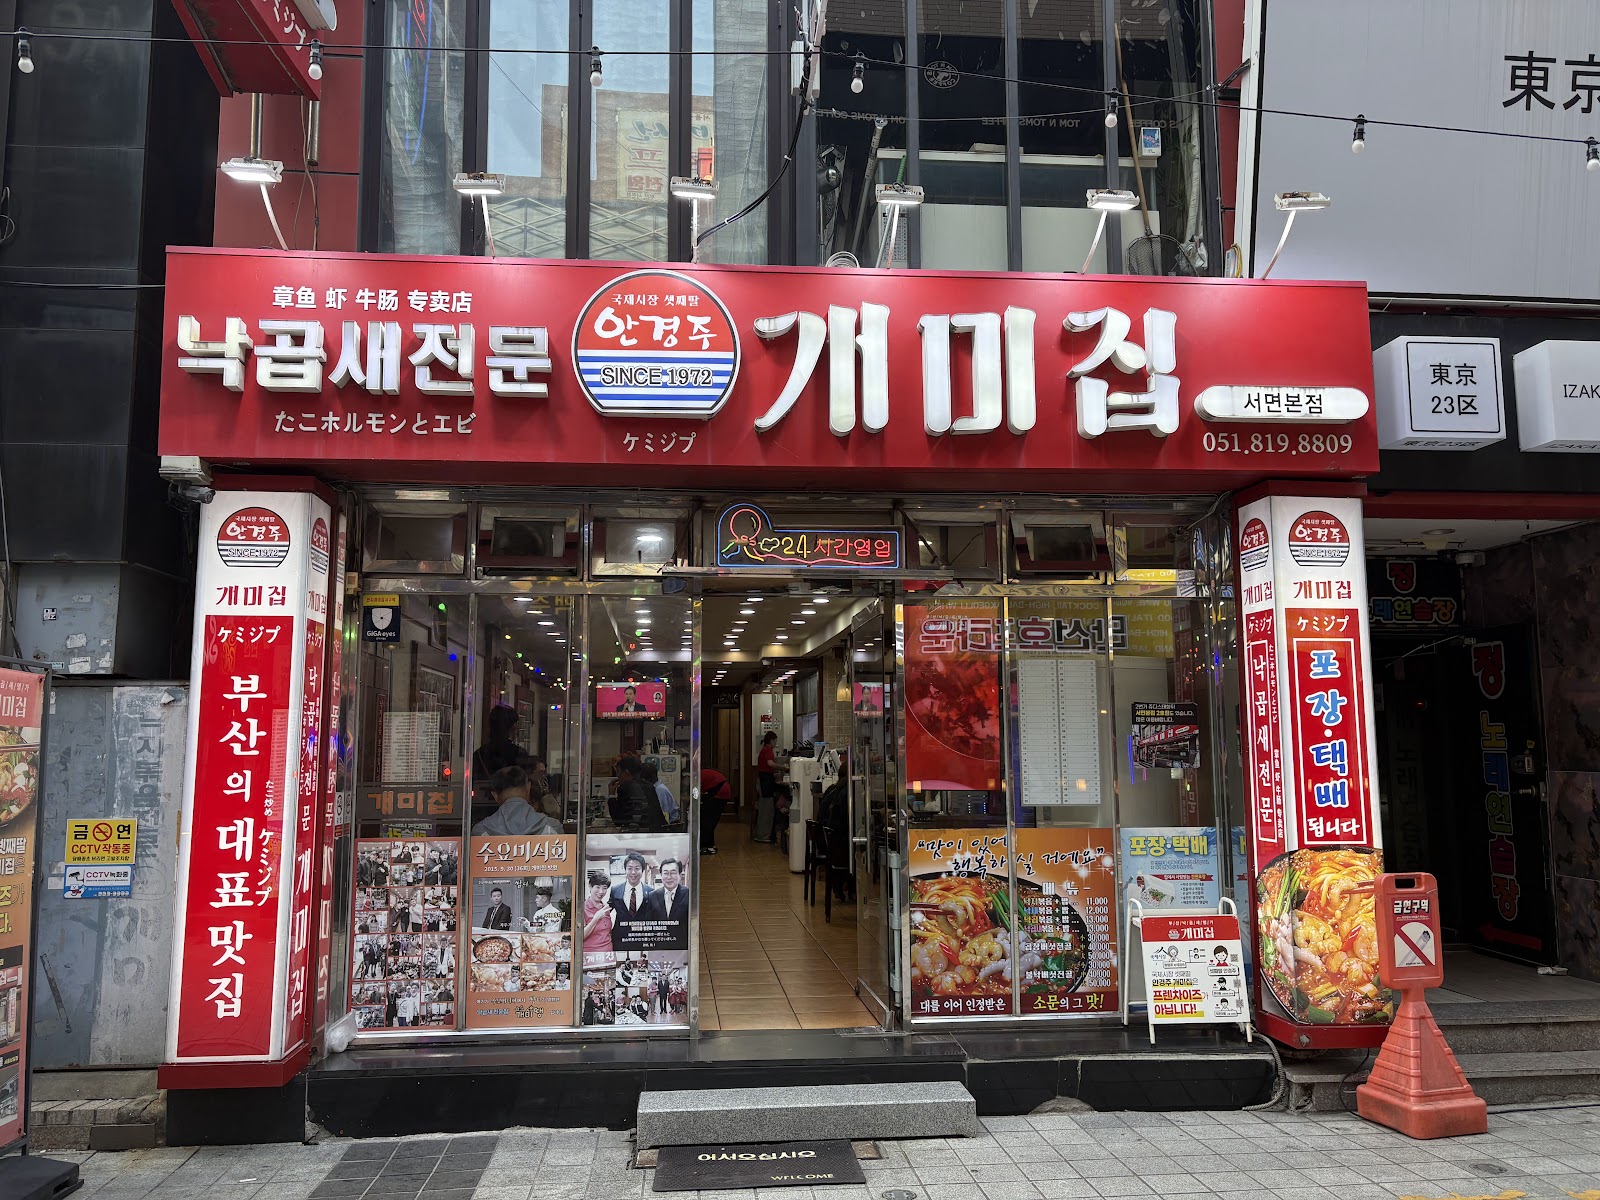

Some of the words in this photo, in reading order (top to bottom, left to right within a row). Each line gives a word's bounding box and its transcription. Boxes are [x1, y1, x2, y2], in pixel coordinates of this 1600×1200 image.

[1502, 51, 1600, 113] 東京
[272, 286, 316, 309] 章鱼
[325, 287, 347, 310] 虾
[355, 288, 399, 311] 牛肠
[407, 289, 473, 313] 专卖店
[611, 293, 659, 307] 국제시장
[593, 305, 718, 350] 안경주
[177, 314, 553, 398] 낙곱새전문
[601, 365, 663, 387] SINCE
[666, 366, 713, 387] 1972
[753, 300, 1181, 440] 개미집
[1429, 362, 1477, 386] 東京
[1243, 391, 1324, 415] 서면본점
[1430, 394, 1479, 416] 23区
[274, 410, 476, 435] たこホルモンとエビ
[622, 431, 697, 454] ケミジプ
[1202, 431, 1354, 457] 051.819.8809
[226, 521, 283, 541] 안경주
[1242, 531, 1266, 549] 안경주
[1295, 524, 1343, 542] 안경주
[227, 547, 256, 557] SINCE
[258, 548, 280, 557] 1972
[1298, 548, 1323, 557] SINCE
[1324, 548, 1342, 557] 1972
[216, 585, 287, 606] 개미집
[1243, 580, 1273, 606] 개미집
[1293, 579, 1352, 600] 개미집
[307, 590, 327, 615] 개미집
[1369, 597, 1457, 624] 래연습장
[217, 625, 282, 643] ケミジプ
[1249, 616, 1273, 634] ケミジプ
[1297, 615, 1350, 632] ケミジプ
[301, 665, 319, 832] 낙곱새전문
[1253, 653, 1274, 823] 낙곱새전문
[367, 790, 453, 815] 개미집
[73, 824, 89, 840] 금
[116, 824, 131, 840] 연
[1306, 816, 1360, 838] 됩니다
[476, 839, 568, 865] 수요미식회
[255, 827, 275, 907] ケミジプ
[1394, 898, 1429, 914] 금연구역
[291, 847, 312, 1022] 개미집
[1181, 927, 1215, 939] 개미집
[919, 998, 940, 1013] 대를
[943, 998, 963, 1012] 이어
[965, 997, 1007, 1012] 인정받은
[1033, 995, 1071, 1010] 소문의
[1072, 998, 1083, 1009] 그
[1154, 1003, 1197, 1015] 아닙니다!
[770, 1172, 835, 1181] WELCOME
